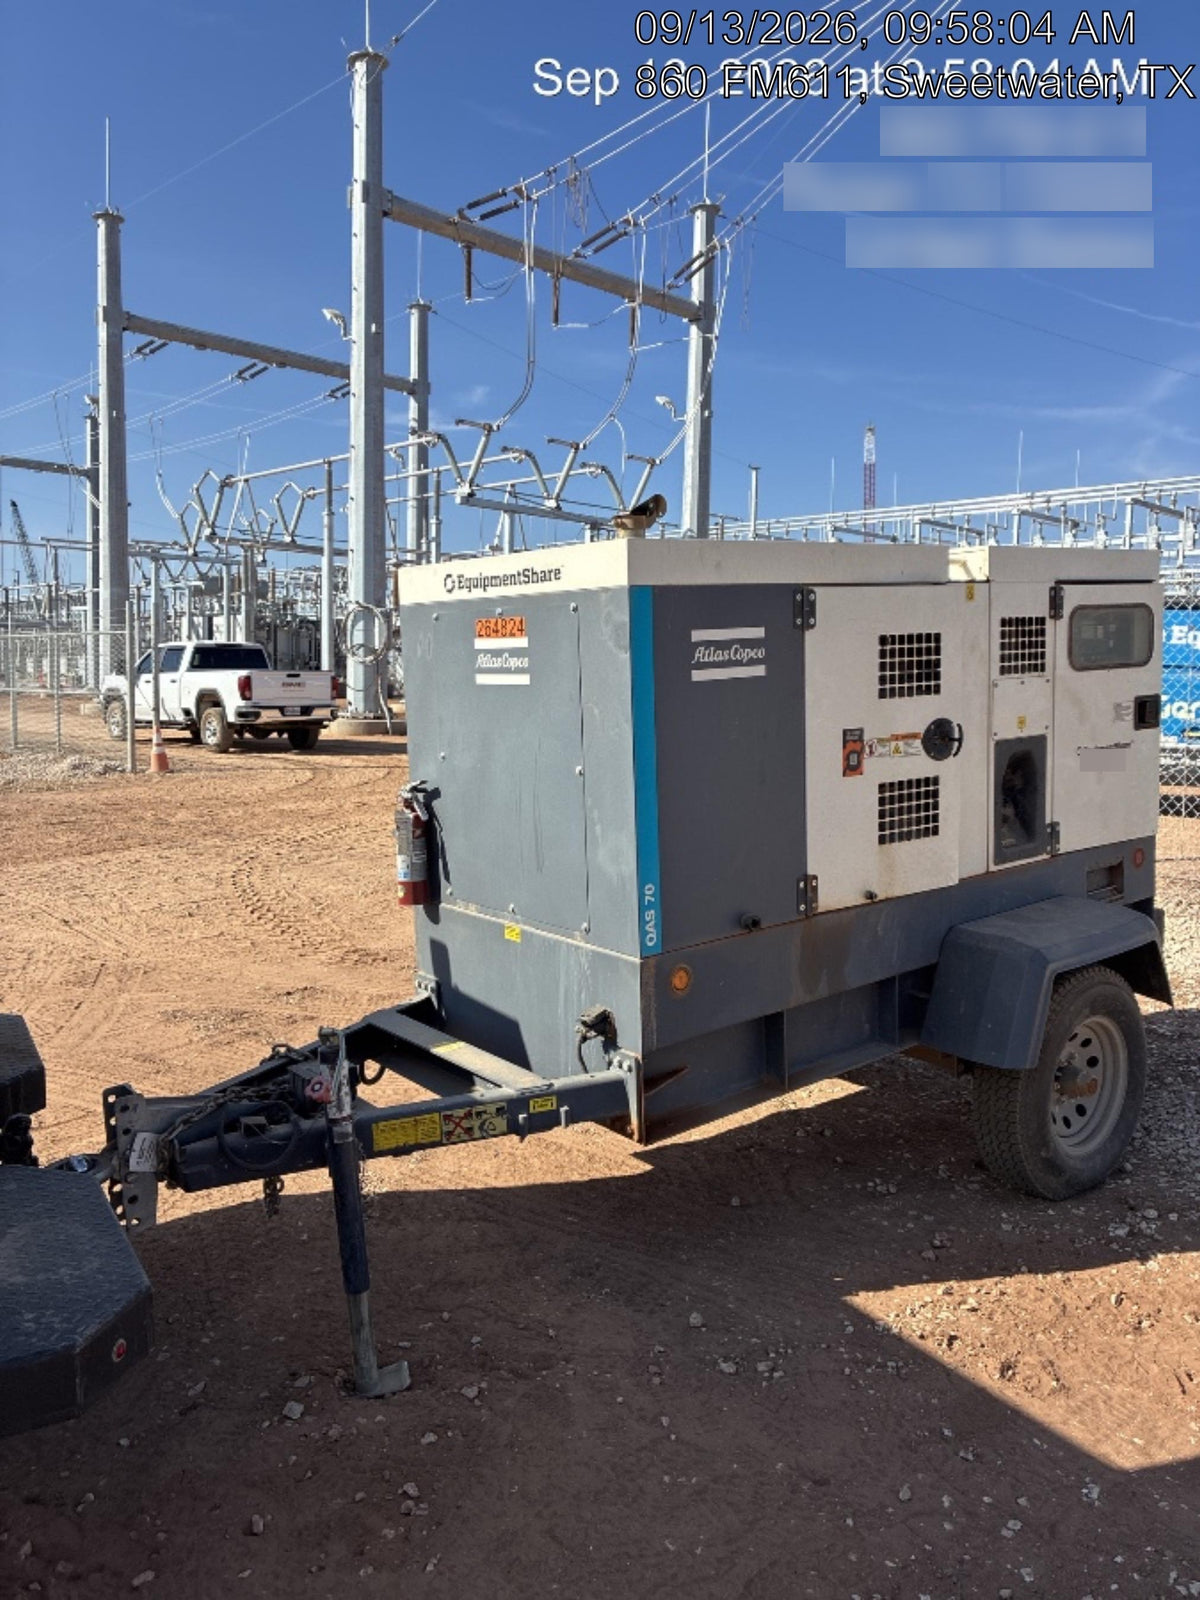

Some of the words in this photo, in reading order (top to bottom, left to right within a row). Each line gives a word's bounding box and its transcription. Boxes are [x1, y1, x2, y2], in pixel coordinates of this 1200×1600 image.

[457, 567, 562, 592] EquipmentShare
[476, 616, 525, 638] 264824
[644, 882, 656, 906] 70
[644, 909, 657, 947] QAS
